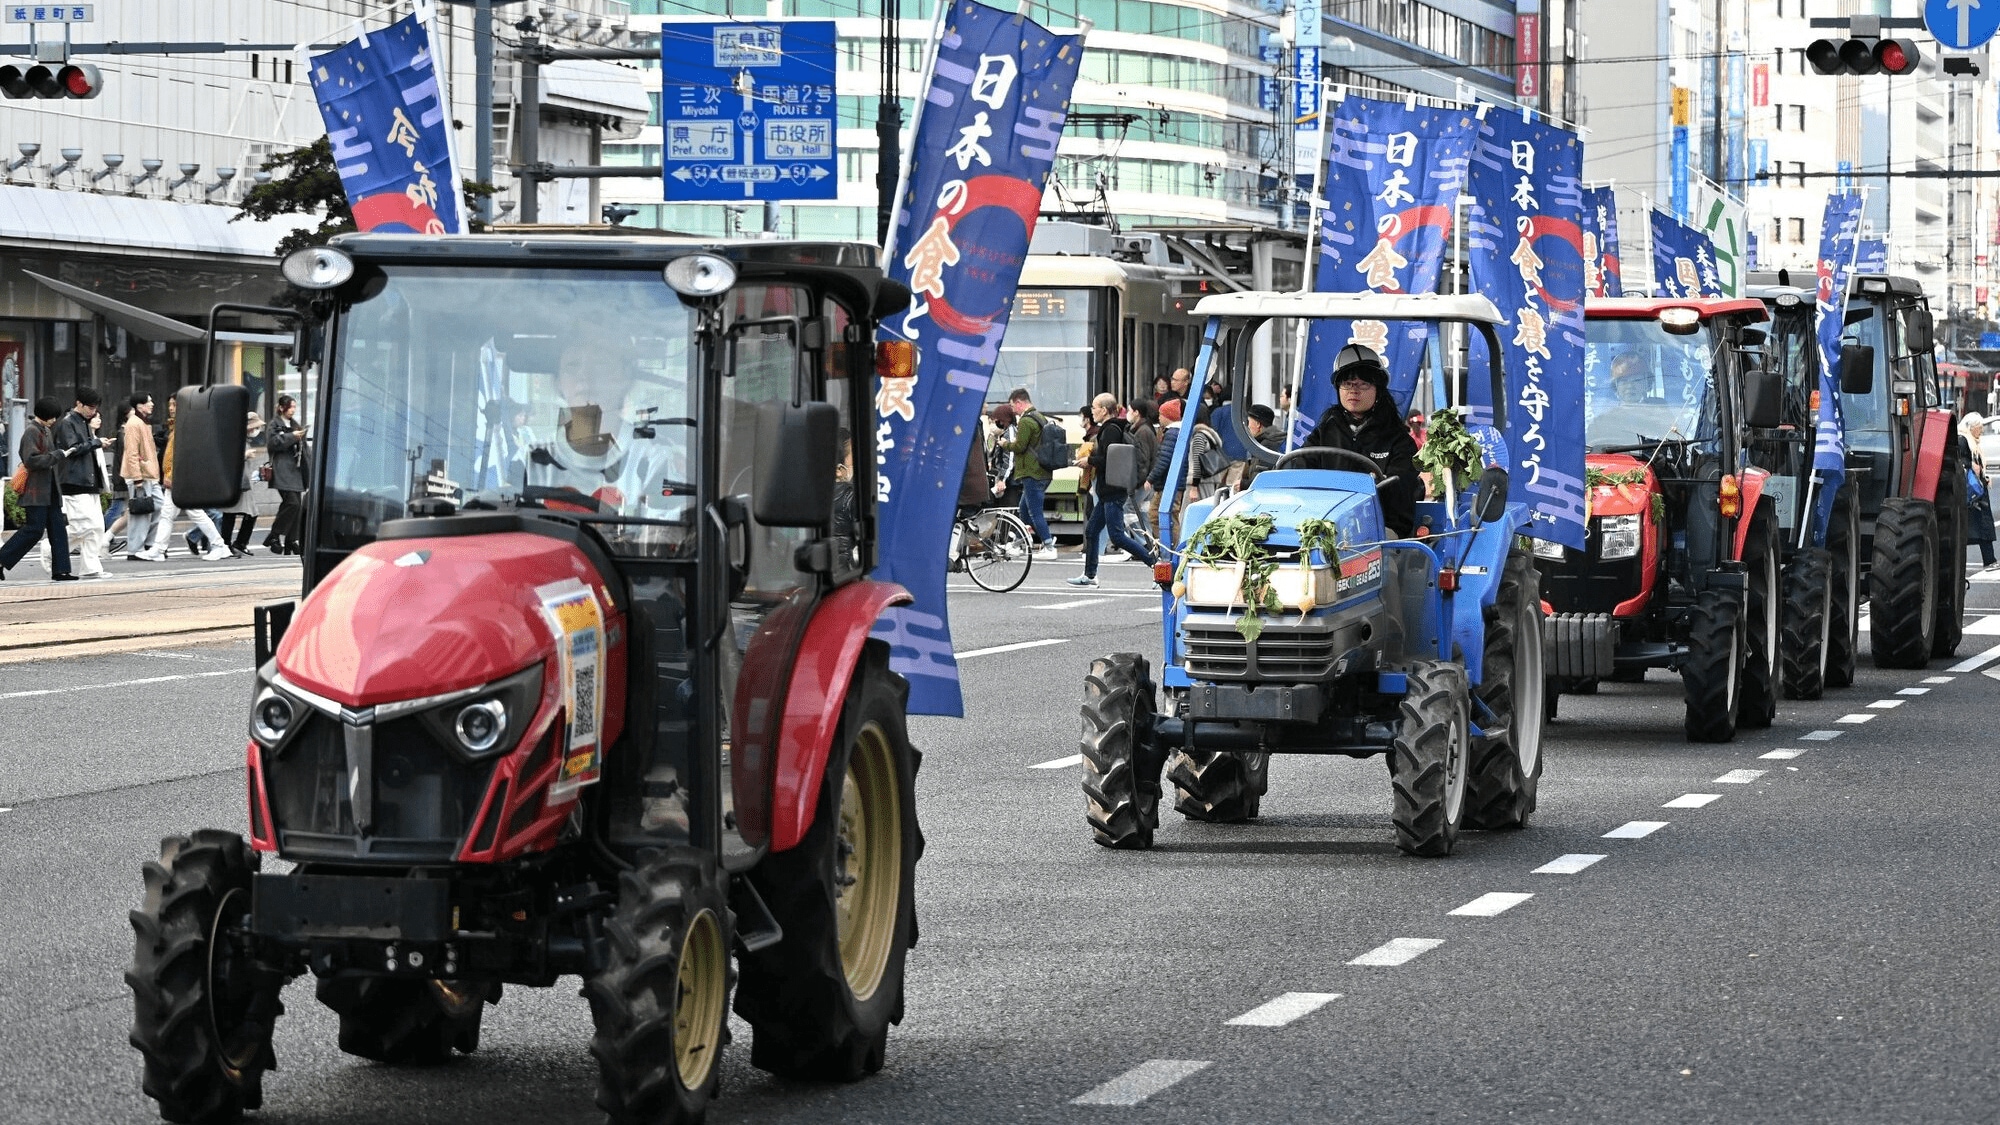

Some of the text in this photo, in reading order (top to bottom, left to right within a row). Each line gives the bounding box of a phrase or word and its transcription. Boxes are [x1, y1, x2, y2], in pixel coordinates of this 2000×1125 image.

[14, 7, 85, 20] 紙屋町西
[720, 33, 776, 50] 広島駅
[679, 86, 721, 104] 三次
[763, 84, 832, 104] 国道2号
[682, 105, 719, 116] Miyoshi
[773, 104, 822, 115] ROUTE 2
[741, 115, 756, 126] 164
[673, 126, 728, 143] 県庁
[769, 125, 826, 143] 市役所
[699, 145, 728, 155] Office
[776, 145, 821, 156] City Hall
[694, 168, 706, 179] 54
[793, 167, 806, 178] 54
[1510, 140, 1551, 485] 日本の食と農を守ろう
